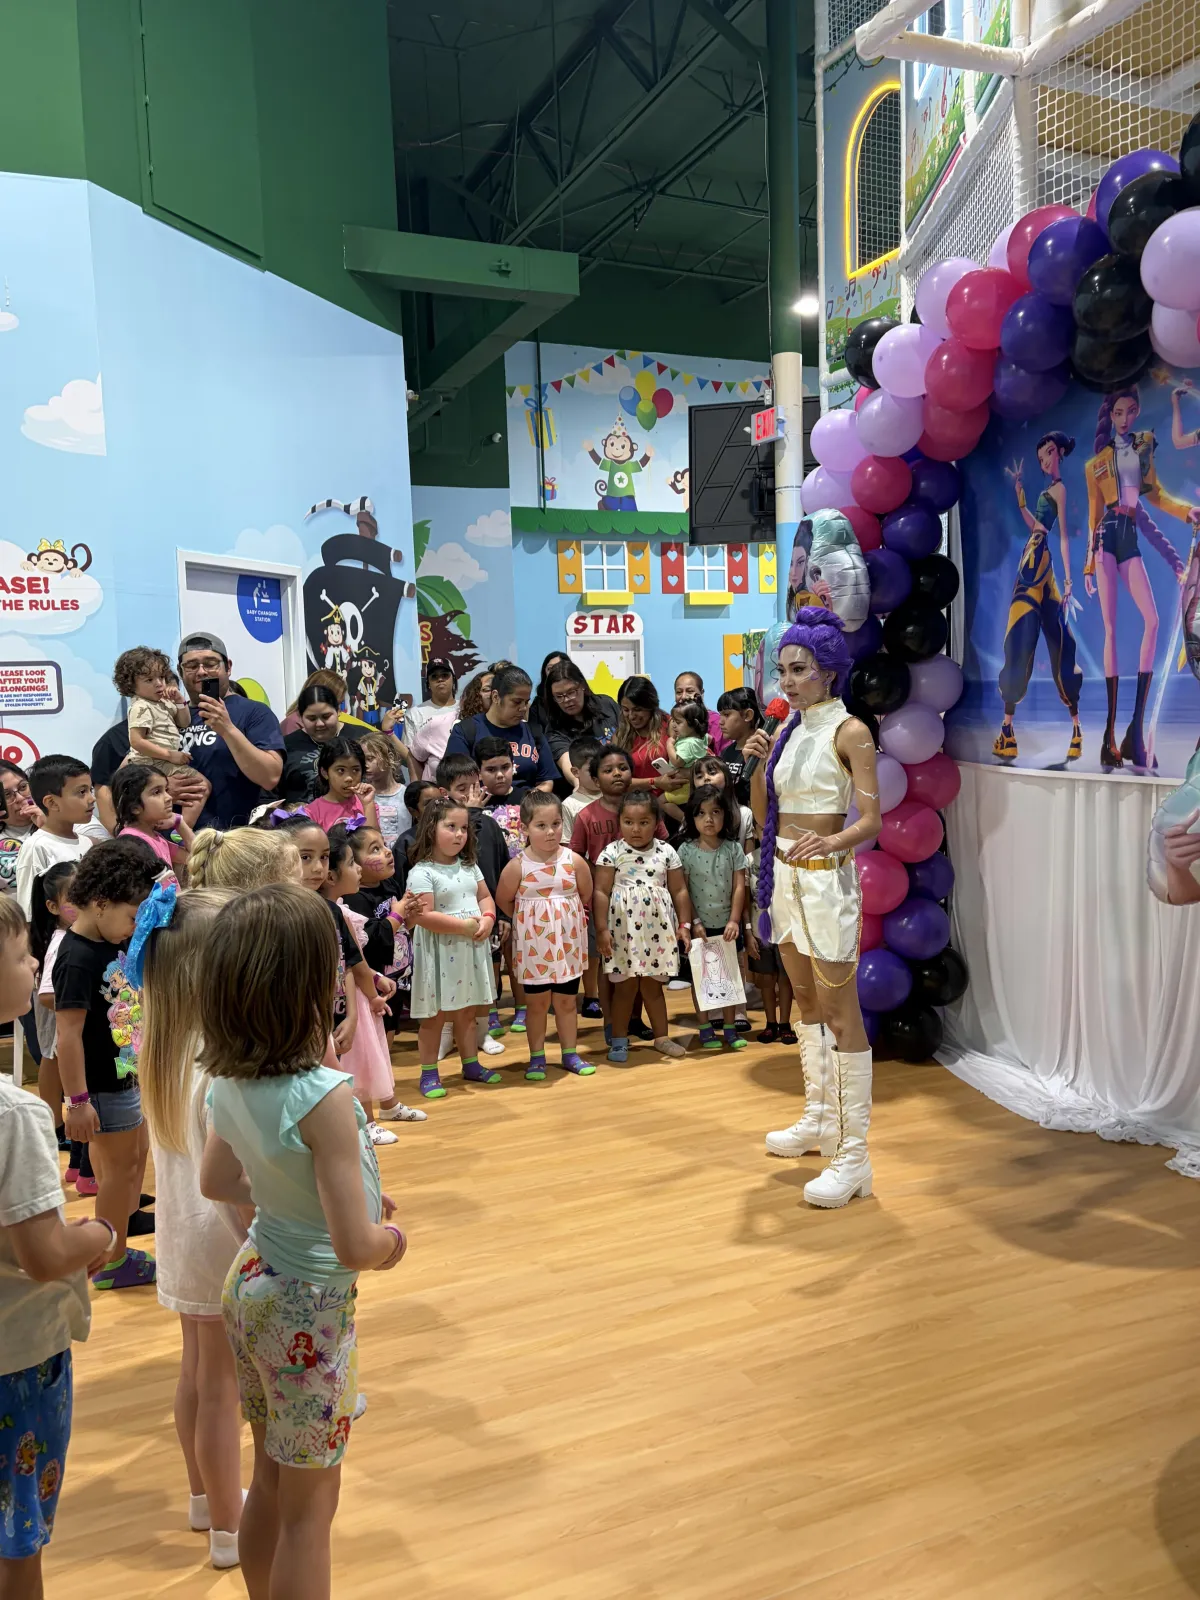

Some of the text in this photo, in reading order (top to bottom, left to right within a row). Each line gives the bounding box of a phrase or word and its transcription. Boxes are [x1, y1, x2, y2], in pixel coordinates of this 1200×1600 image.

[756, 408, 775, 440] EXIT
[0, 600, 80, 611] HE RULES
[574, 614, 635, 635] STAR
[24, 677, 45, 685] YOUR
[0, 685, 49, 693] ELONGINGS!
